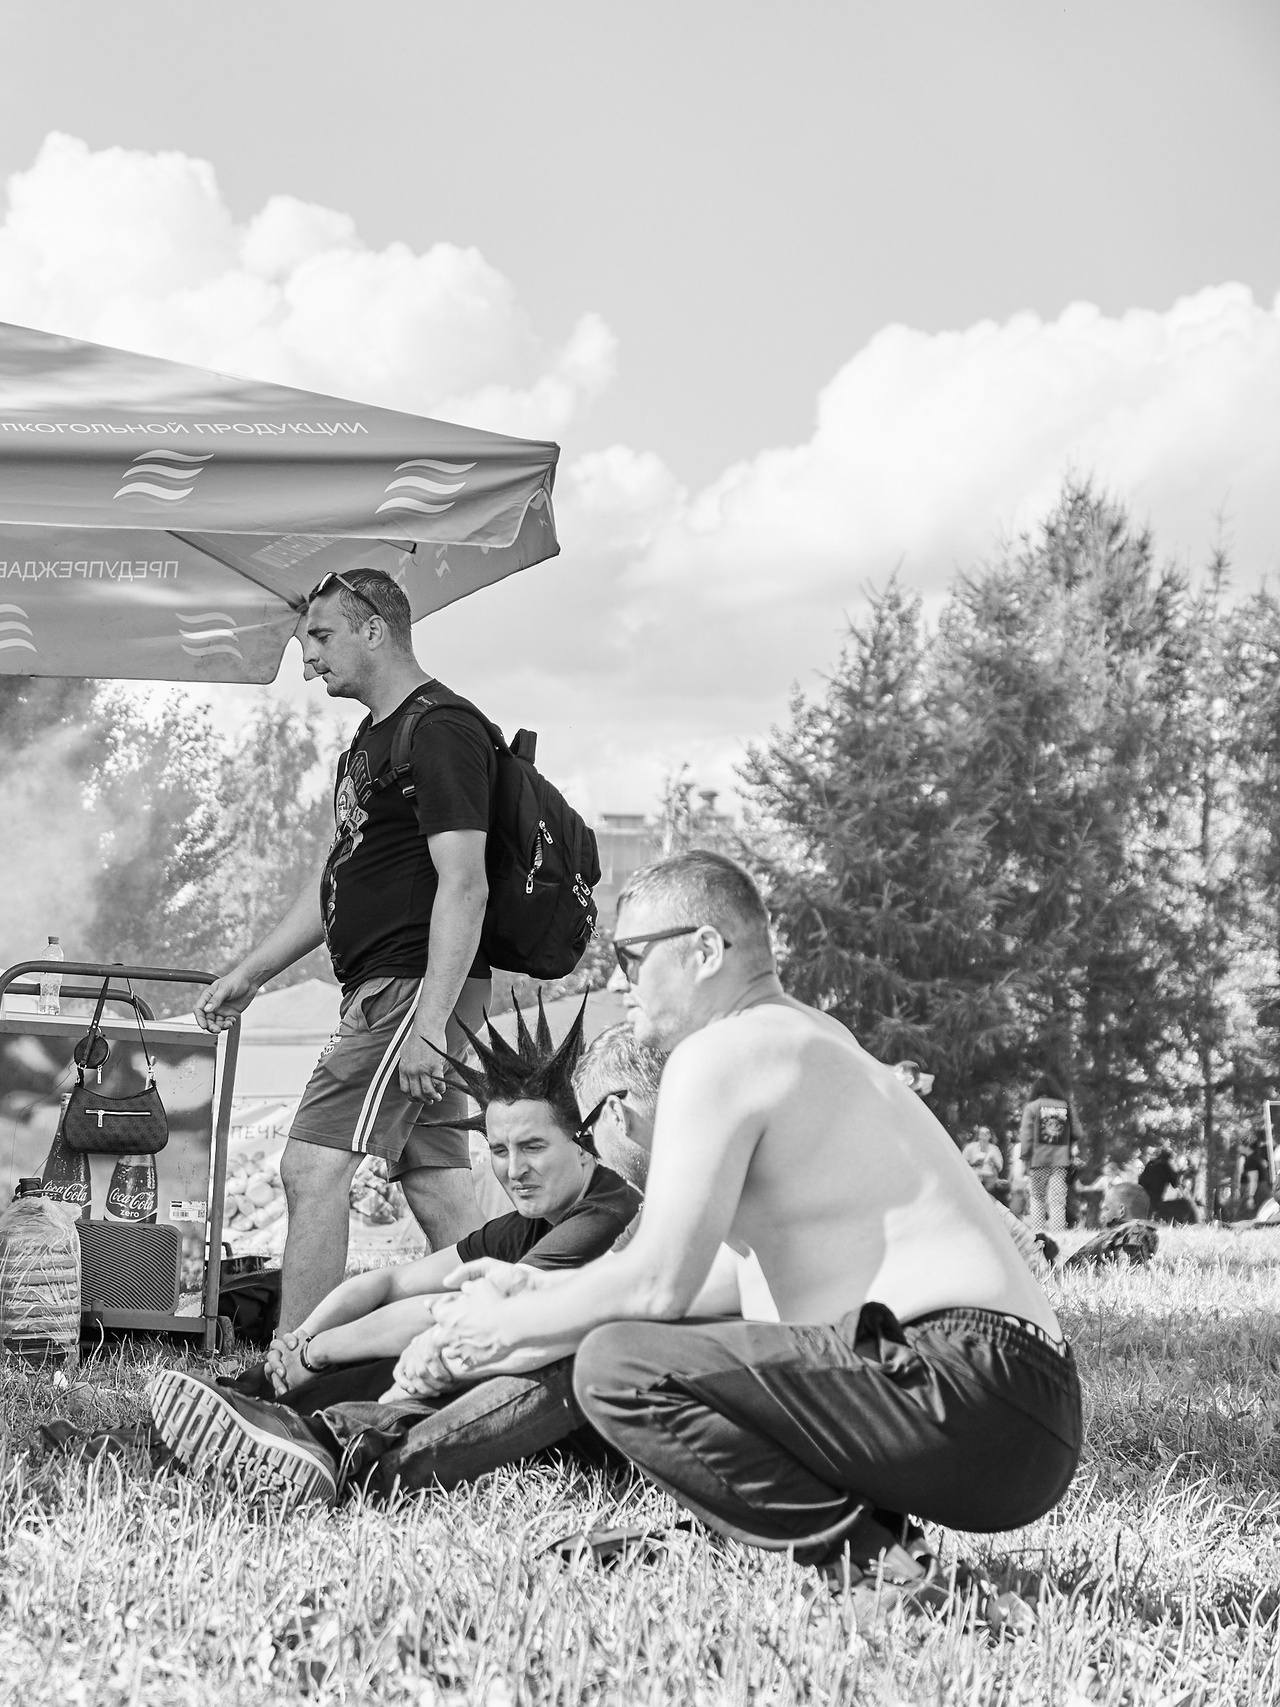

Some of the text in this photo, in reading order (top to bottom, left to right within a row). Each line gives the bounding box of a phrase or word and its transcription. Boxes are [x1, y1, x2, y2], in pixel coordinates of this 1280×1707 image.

[193, 421, 369, 436] ПРОДУКЦИИ
[109, 1187, 156, 1211] Coca-Cola
[120, 1209, 140, 1218] zero
